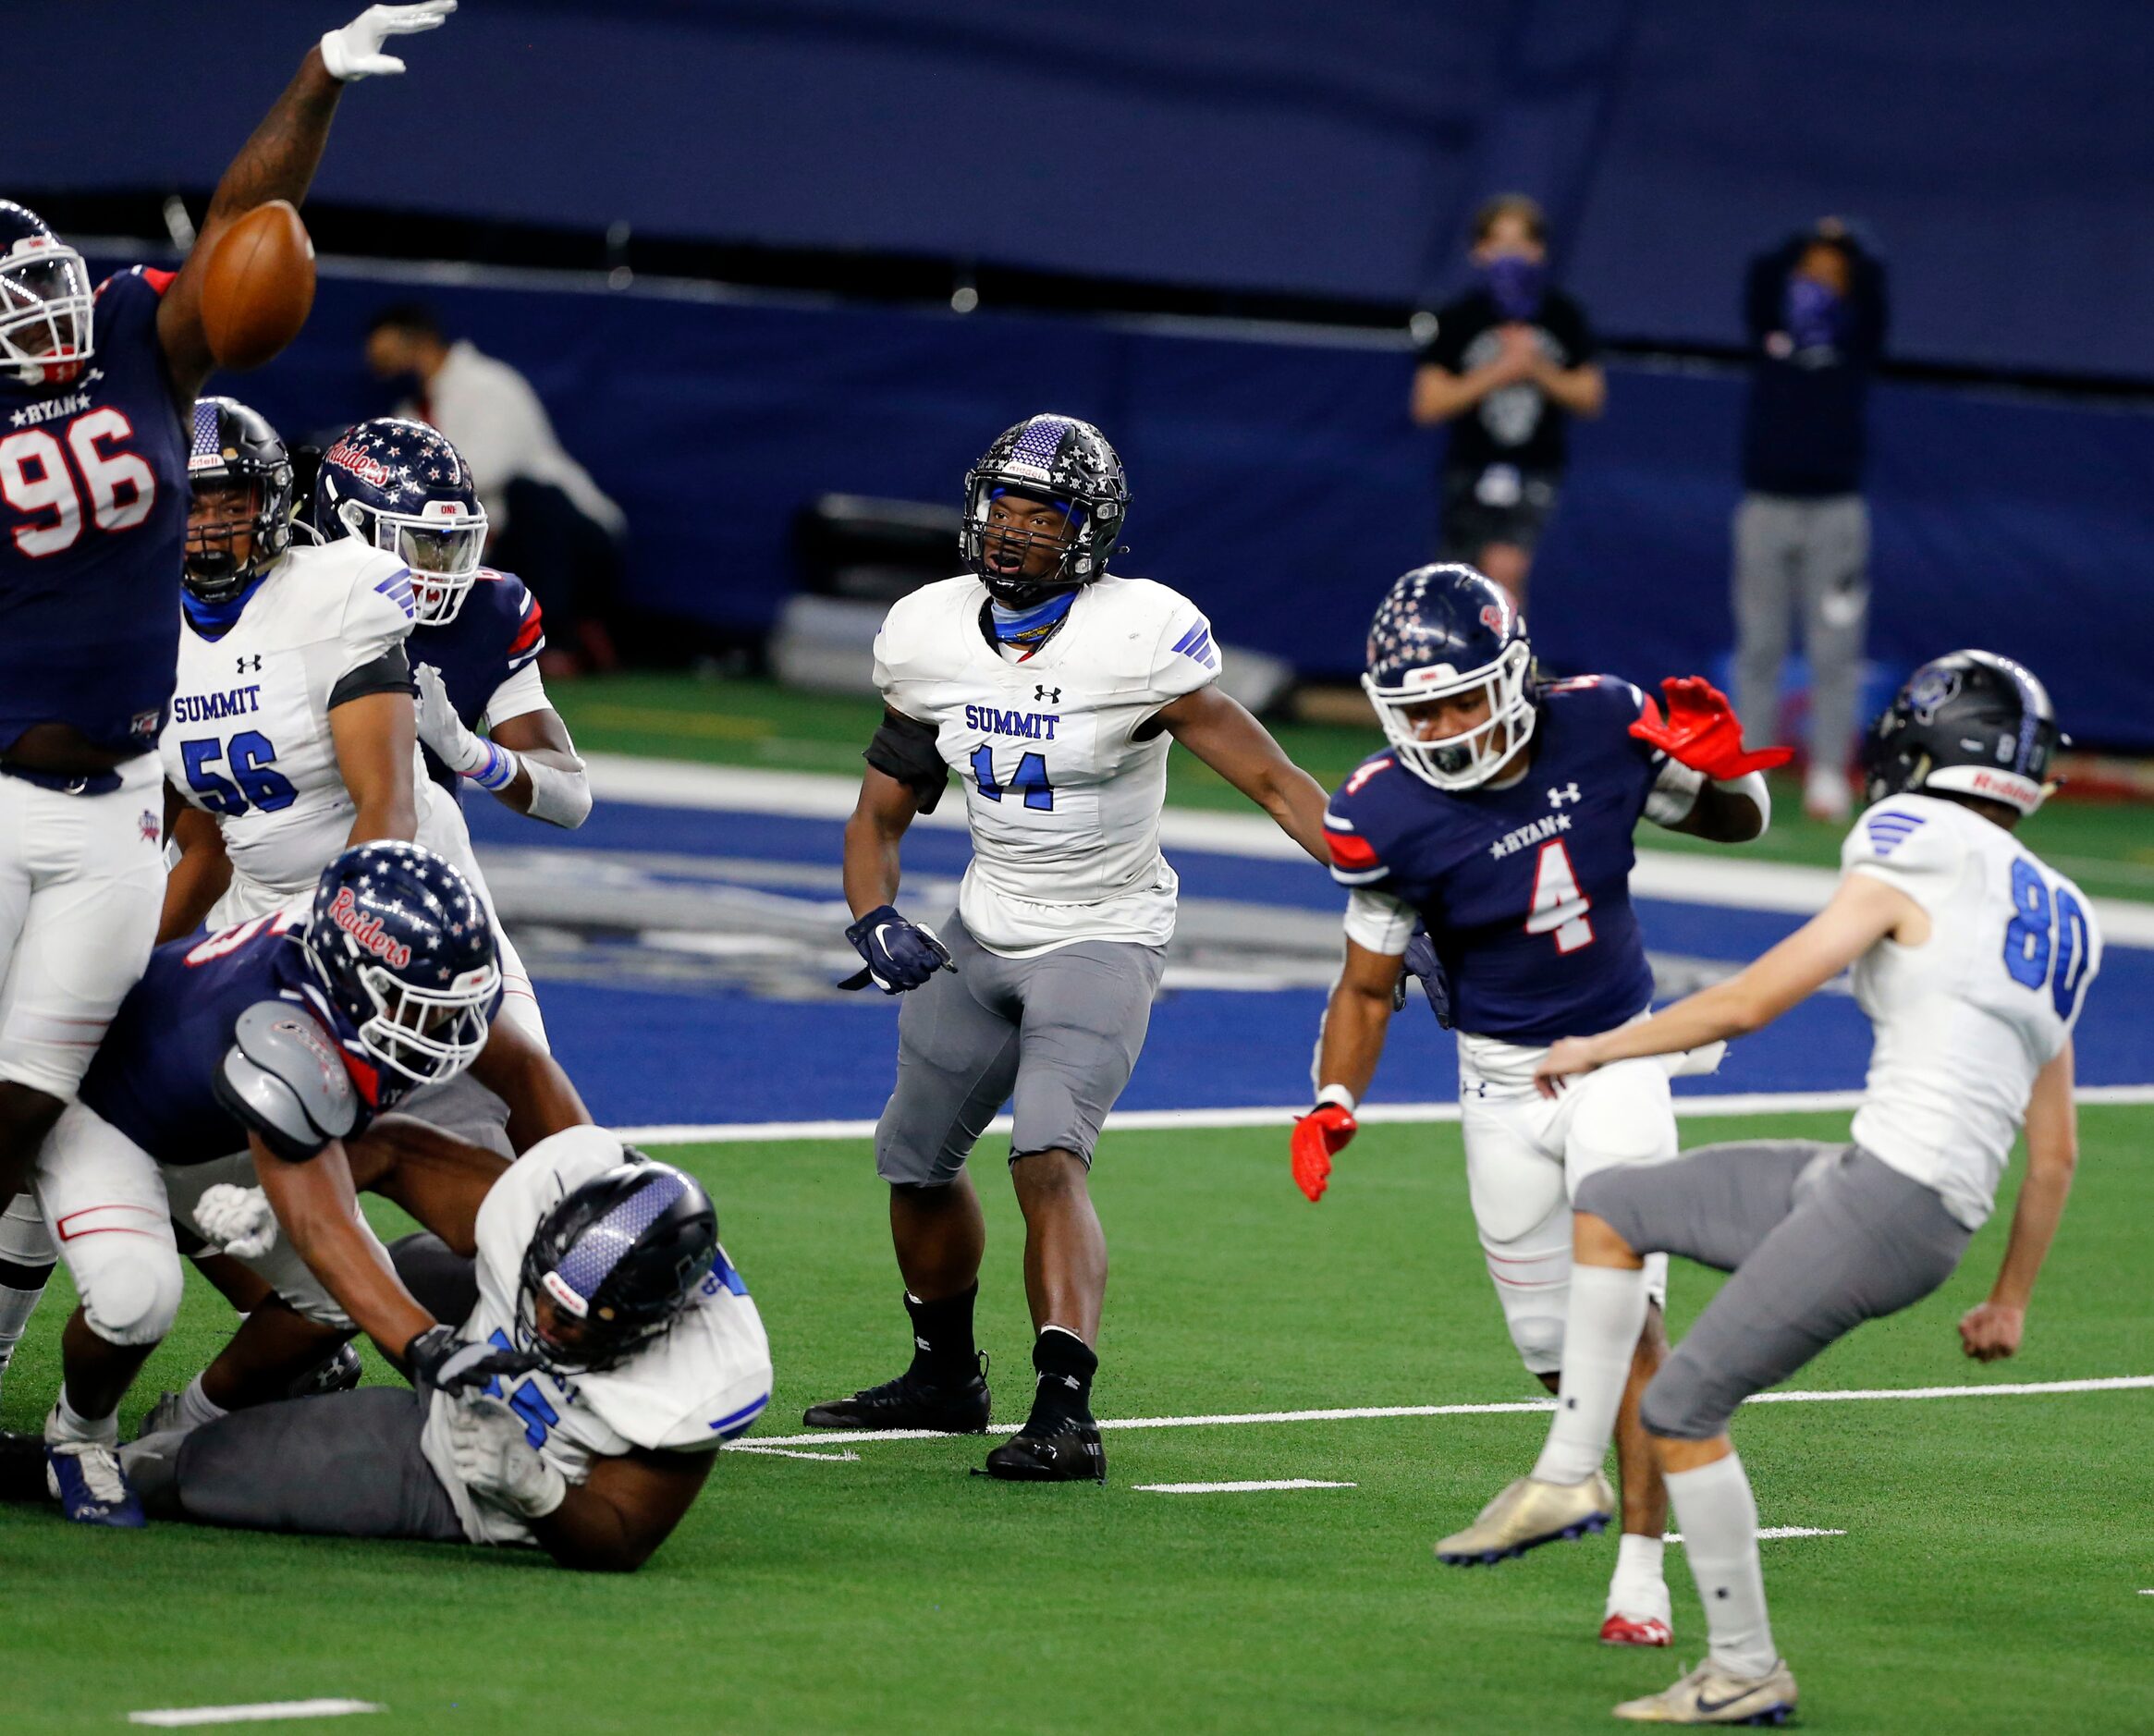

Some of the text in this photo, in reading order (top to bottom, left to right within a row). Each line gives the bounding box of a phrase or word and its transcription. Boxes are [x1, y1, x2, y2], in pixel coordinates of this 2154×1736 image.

[26, 394, 78, 425] RYAN
[0, 405, 157, 559] 96
[326, 434, 391, 487] Raiders
[440, 505, 457, 515] ONE
[174, 684, 261, 724] SUMMIT
[965, 704, 1059, 740] SUMMIT
[179, 729, 300, 818] 56
[970, 743, 1055, 812] 14
[1502, 814, 1558, 855] RYAN
[1524, 836, 1597, 956] 4
[328, 886, 411, 971] Raiders
[2002, 856, 2089, 1022] 80
